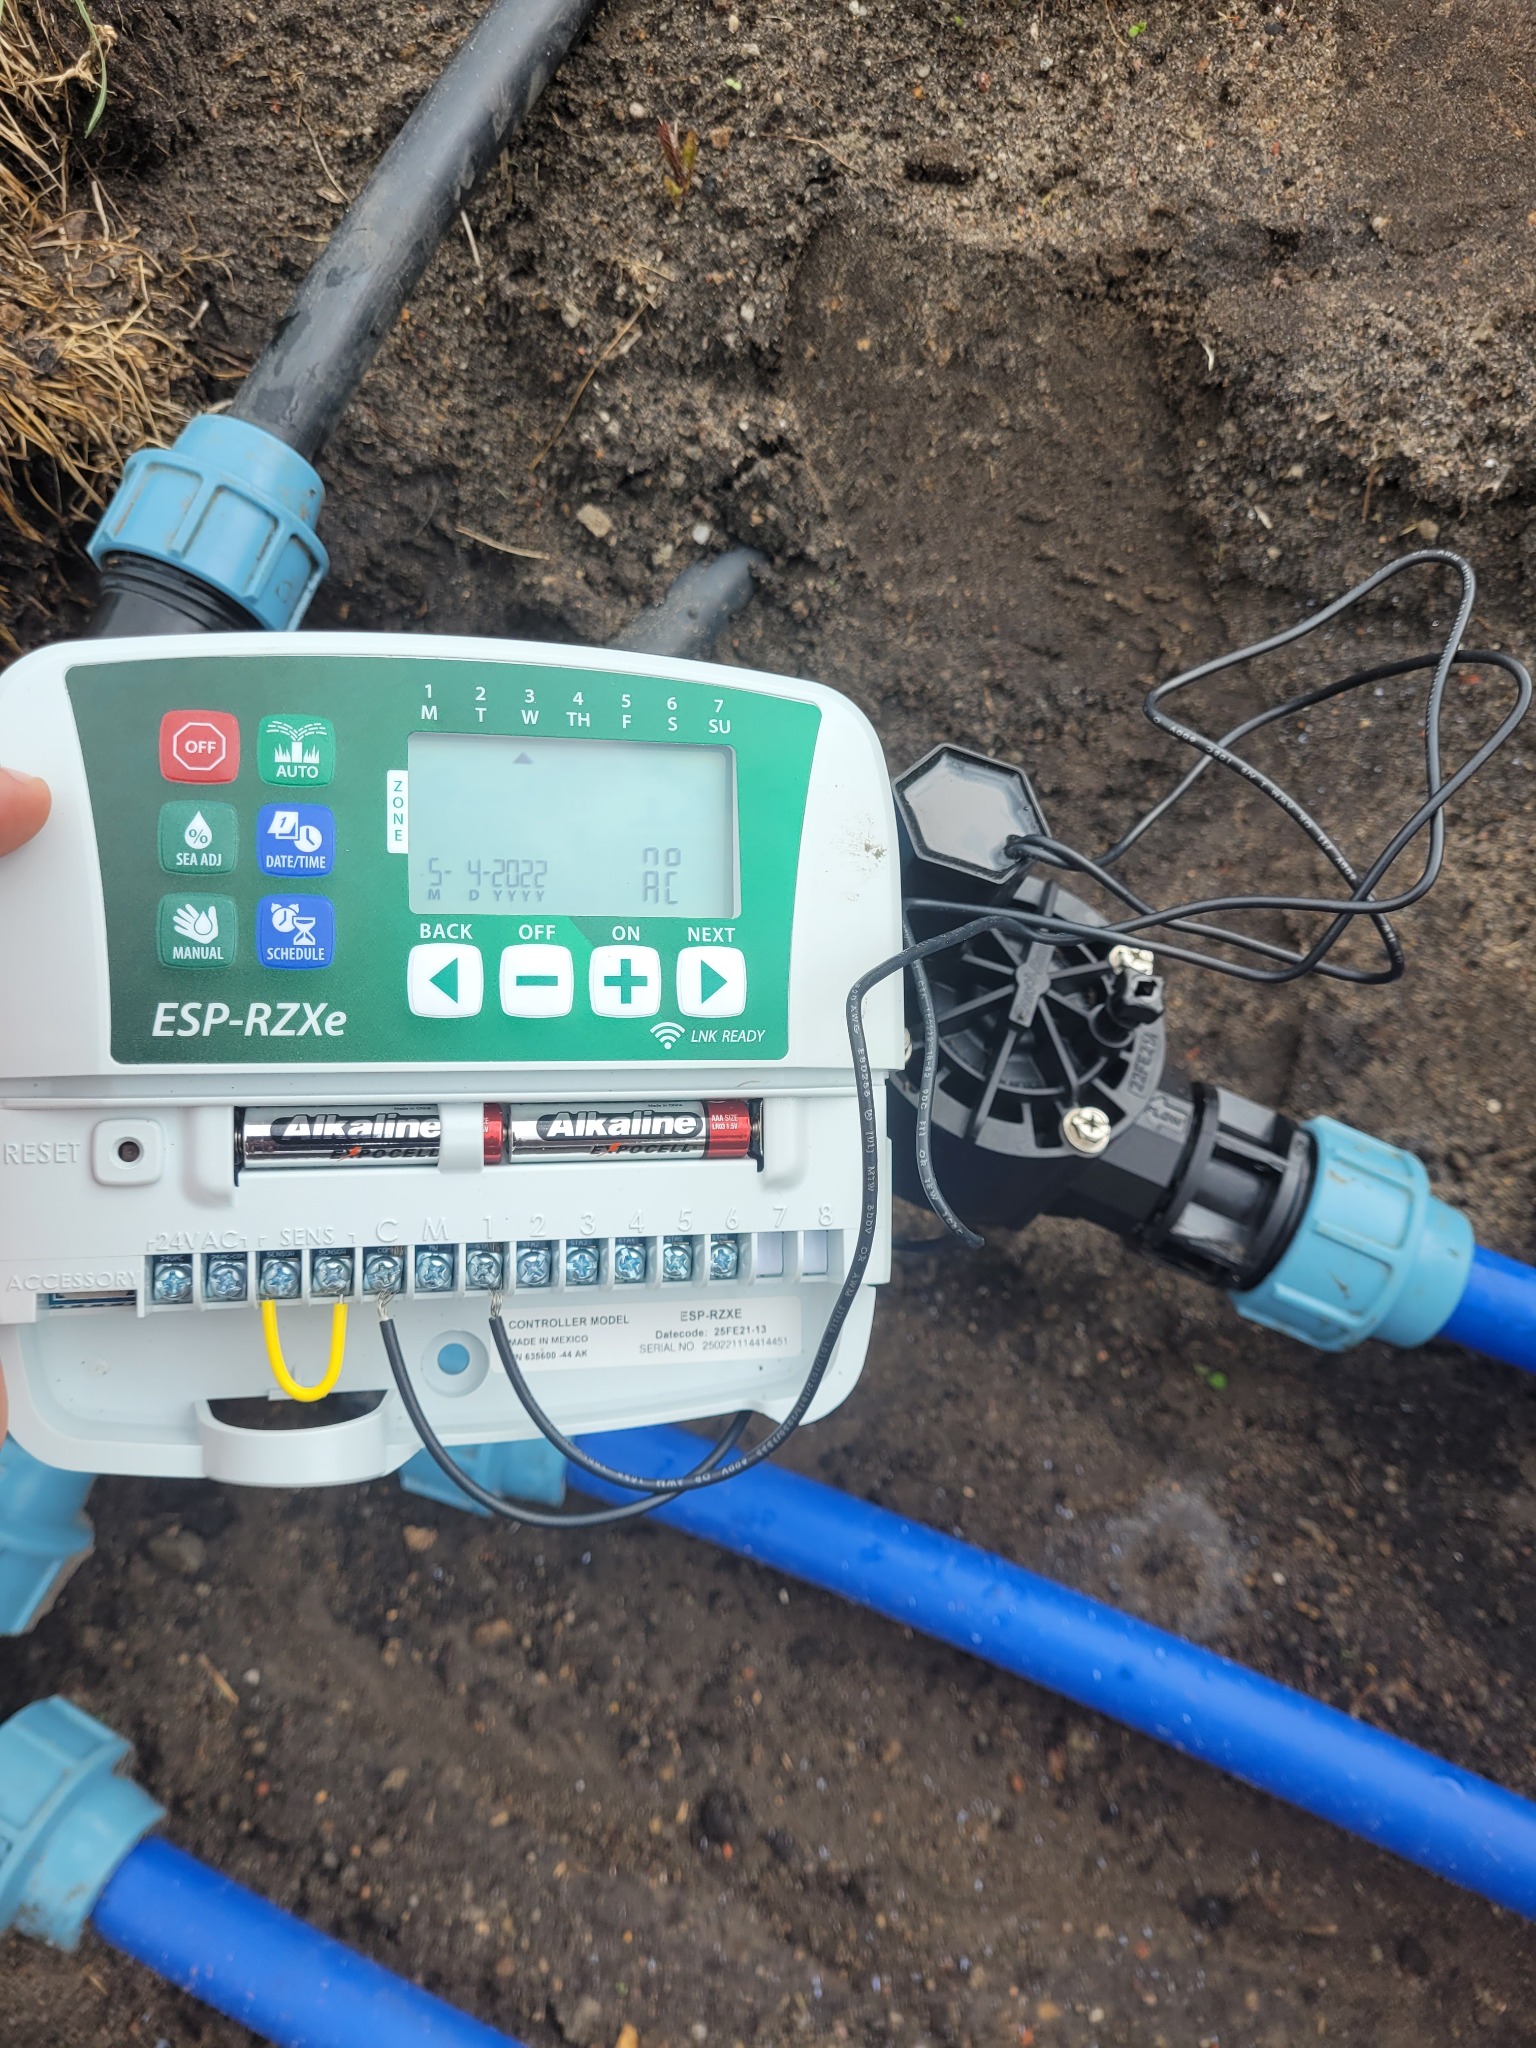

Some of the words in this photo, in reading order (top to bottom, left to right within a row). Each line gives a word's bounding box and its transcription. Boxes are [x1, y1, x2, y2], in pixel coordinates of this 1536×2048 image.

[424, 684, 433, 698] 1
[475, 686, 487, 701] 2
[525, 689, 535, 703] 3
[572, 692, 584, 706] 4
[621, 694, 631, 708] 5
[667, 697, 677, 711] 6
[714, 699, 724, 713] 7
[421, 705, 438, 720] M
[475, 707, 487, 722] T
[521, 710, 539, 724] W
[566, 712, 590, 727] TH
[622, 714, 632, 729] F
[668, 717, 678, 731] S
[709, 719, 731, 734] SU
[184, 740, 216, 754] OFF
[276, 765, 319, 778] AUTO
[393, 780, 404, 841] ZONE
[176, 853, 198, 866] SEA
[200, 854, 222, 867] ADJ
[266, 855, 326, 869] DATE/TIME
[428, 889, 441, 901] M
[469, 889, 479, 901] D
[643, 870, 679, 905] AC
[419, 923, 473, 940] BACK
[518, 924, 556, 941] OFF
[612, 925, 640, 941] ON
[687, 927, 736, 943] NEXT
[173, 946, 224, 960] MANUAL
[267, 947, 325, 961] SCHEDULE
[152, 1002, 347, 1037] ESP-RZXe
[691, 1029, 718, 1043] LNK
[722, 1029, 766, 1043] READY
[282, 1113, 441, 1140] Alkaline
[546, 1110, 698, 1137] Alkaline
[711, 1114, 724, 1122] AAA
[725, 1114, 738, 1122] SIZE
[3, 1142, 81, 1165] RESET
[918, 1148, 927, 1167] OR
[580, 1211, 596, 1236] 3
[628, 1209, 645, 1234] 4
[677, 1207, 693, 1232] 5
[725, 1206, 740, 1230] 6
[773, 1204, 788, 1228] 7
[818, 1203, 834, 1227] 8
[375, 1218, 399, 1243] C
[422, 1216, 450, 1242] M
[482, 1215, 493, 1240] 1
[530, 1213, 546, 1238] 2
[280, 1227, 335, 1247] SENS
[857, 1246, 867, 1262] OR
[6, 1270, 140, 1292] ACCESSORY
[508, 1316, 586, 1330] CONTROLLER
[590, 1314, 629, 1326] MODEL
[680, 1308, 742, 1322] ESP-RZXE
[509, 1337, 537, 1347] MADE
[539, 1336, 549, 1345] IN
[551, 1335, 589, 1344] MEXICO
[655, 1327, 708, 1340] Datecode:
[713, 1325, 767, 1337] 25FE21-13
[575, 1349, 588, 1358] AK
[639, 1343, 675, 1354] SERIAL
